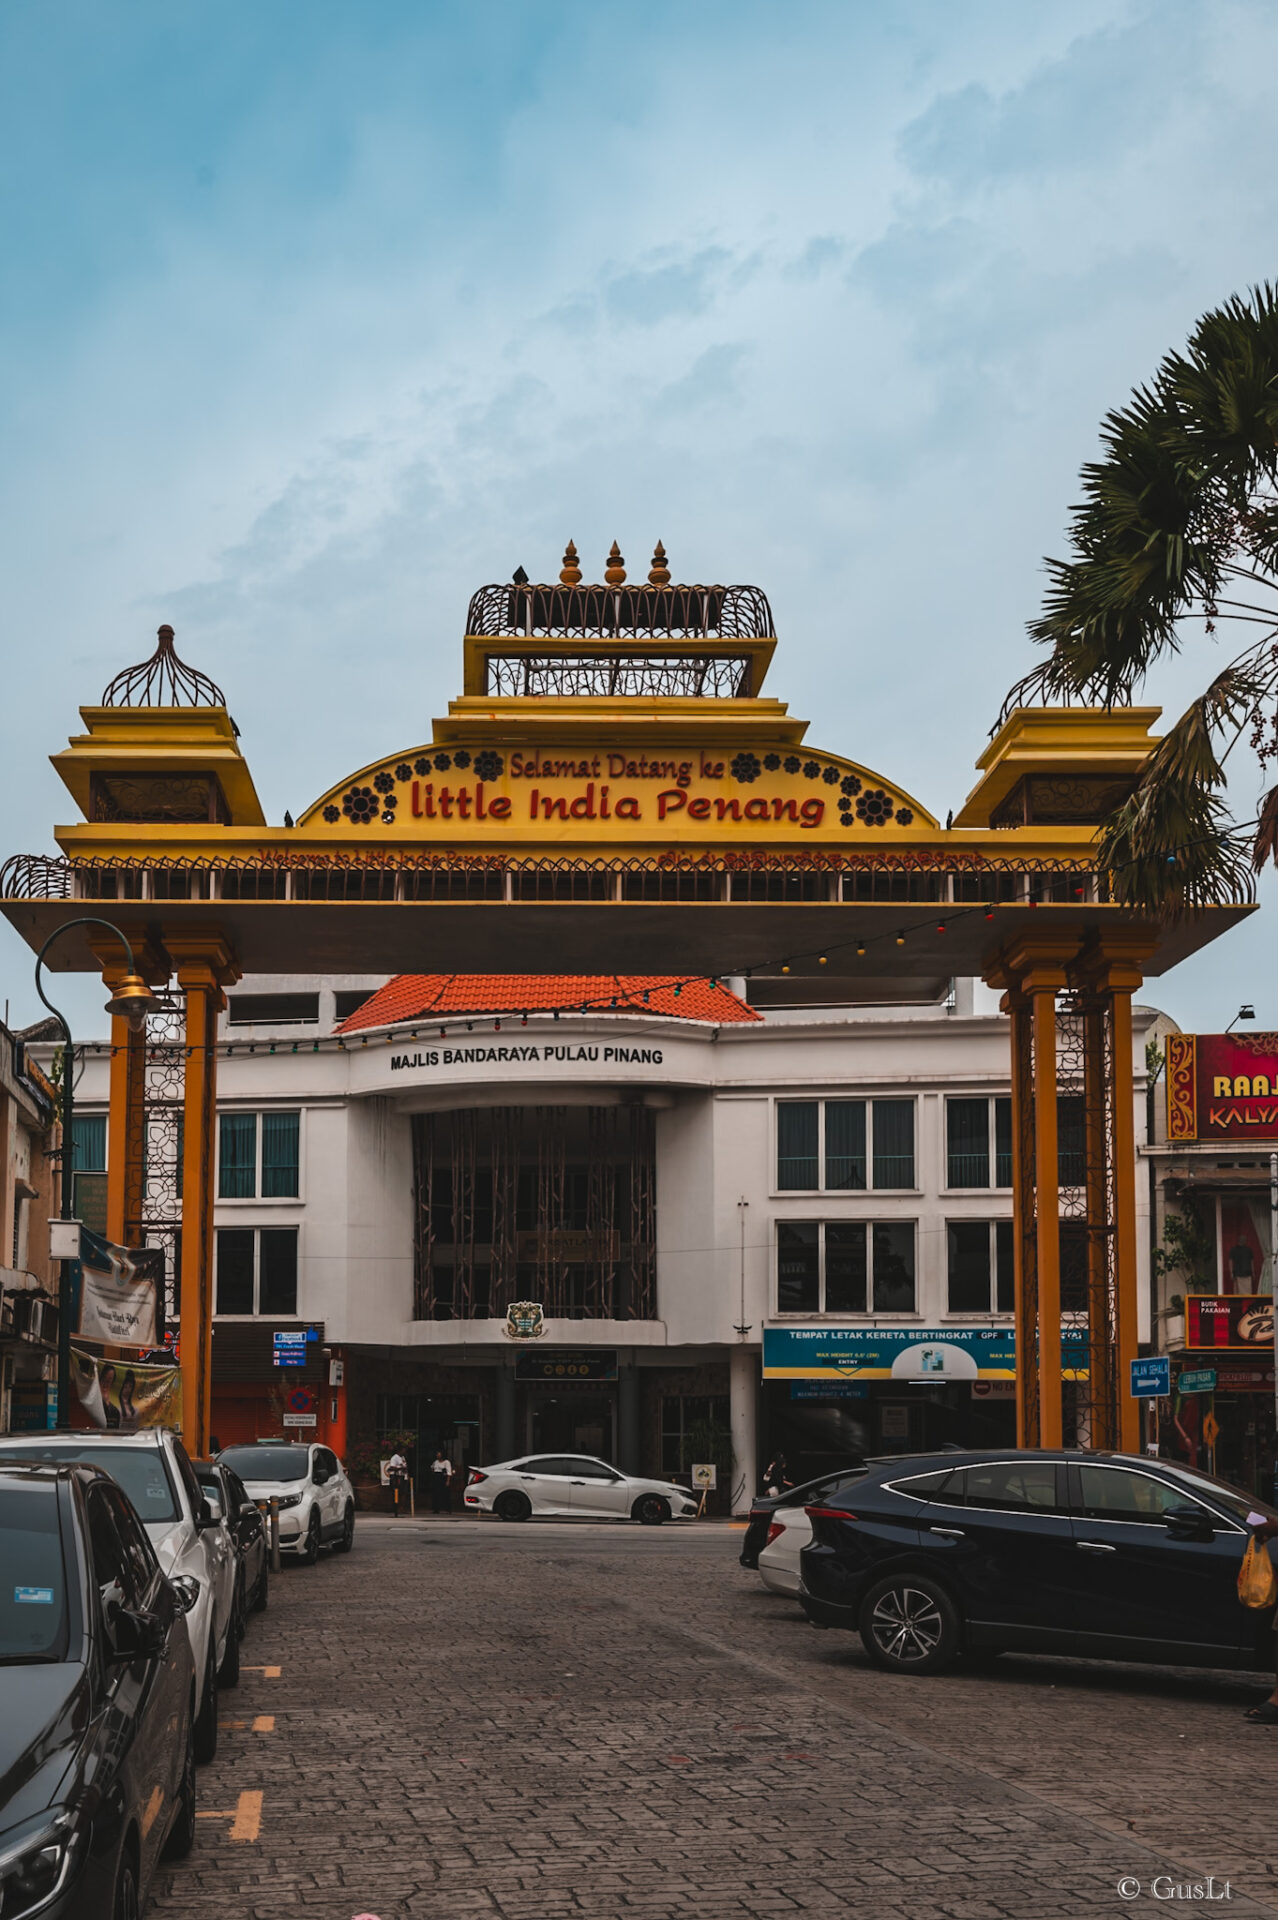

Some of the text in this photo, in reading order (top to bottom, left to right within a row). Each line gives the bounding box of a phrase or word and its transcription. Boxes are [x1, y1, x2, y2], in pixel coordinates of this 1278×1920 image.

[510, 750, 725, 787] Selamat Datang ke
[410, 781, 826, 829] little India Penang
[390, 1046, 663, 1070] MAJLIS BANDARAYA PULAU PINANG
[789, 1331, 828, 1339] TEMPAT
[831, 1331, 863, 1339] LETAK
[866, 1331, 905, 1339] KERETA
[909, 1332, 973, 1340] BERTINGKAT
